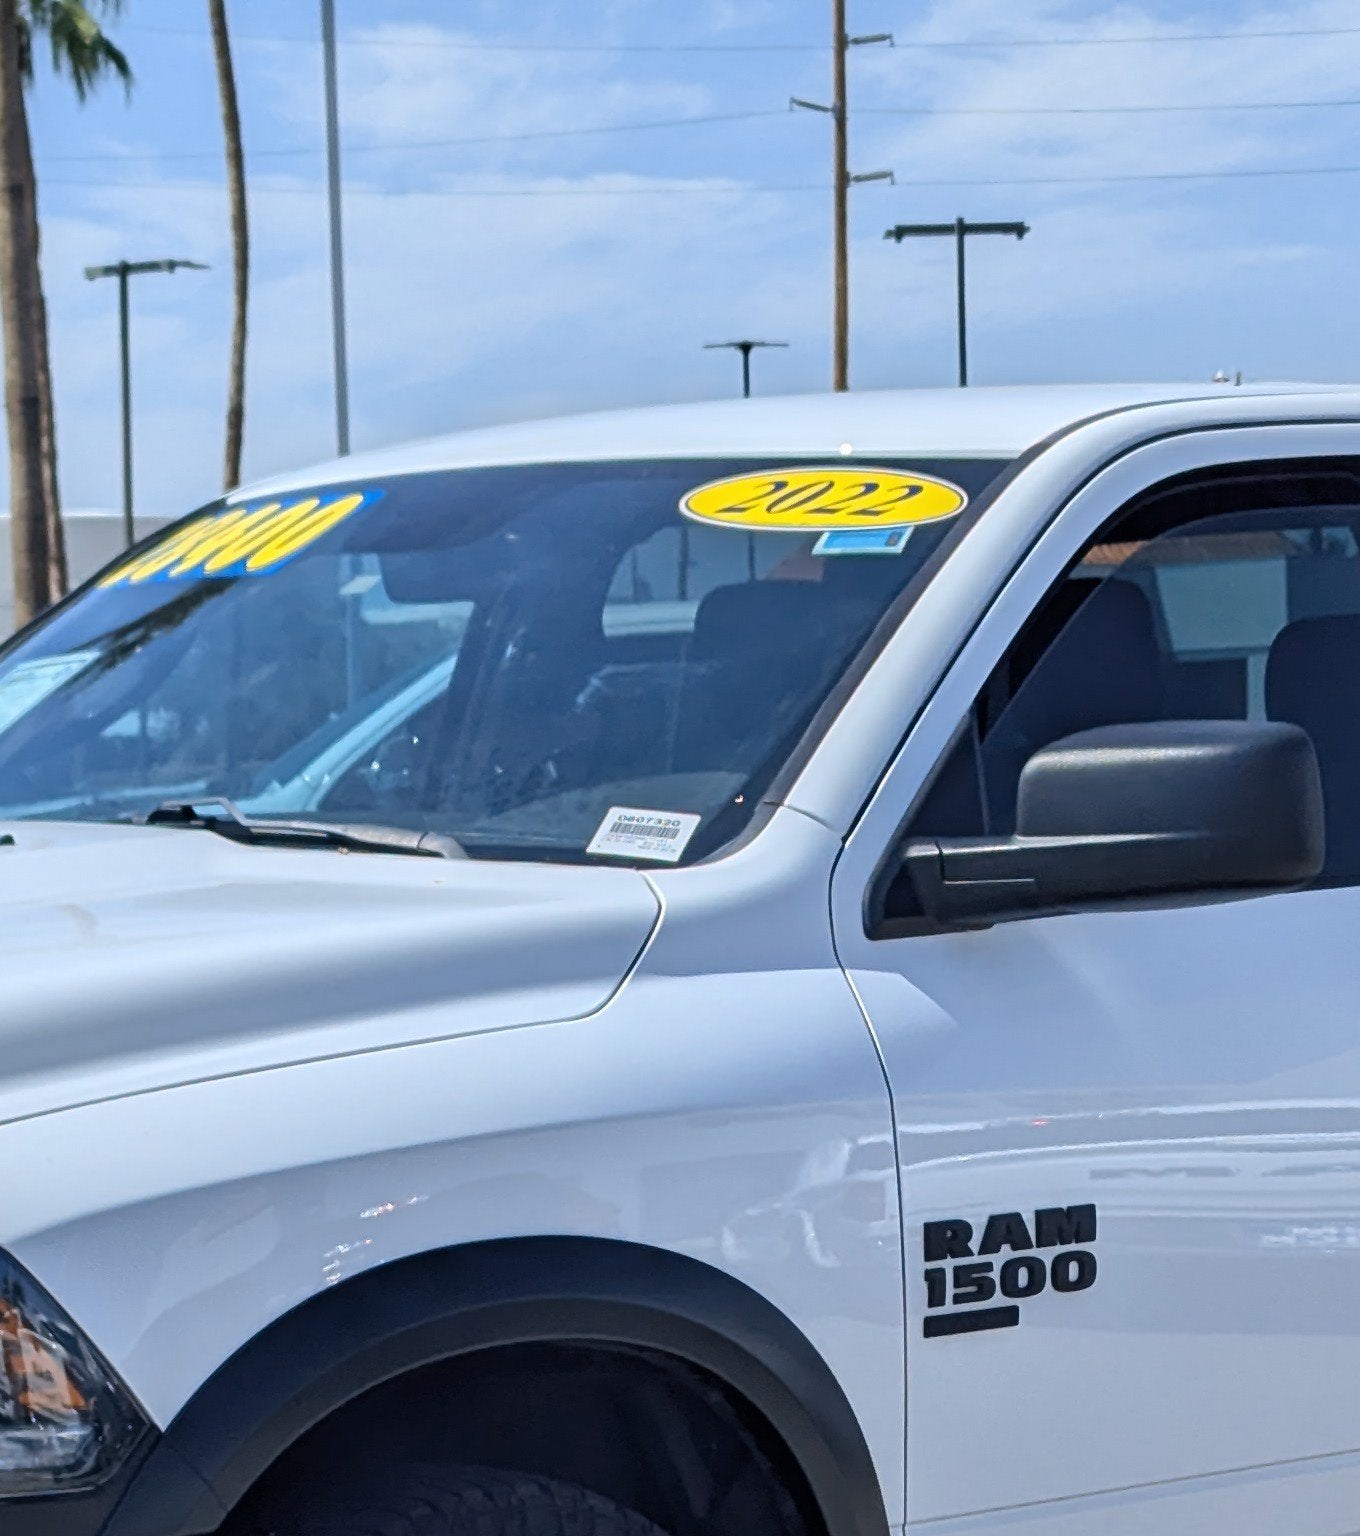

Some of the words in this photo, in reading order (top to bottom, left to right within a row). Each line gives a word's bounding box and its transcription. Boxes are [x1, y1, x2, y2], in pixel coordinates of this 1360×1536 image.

[716, 480, 924, 517] 2022
[923, 1203, 1097, 1262] RAM
[924, 1250, 1097, 1309] 1500
